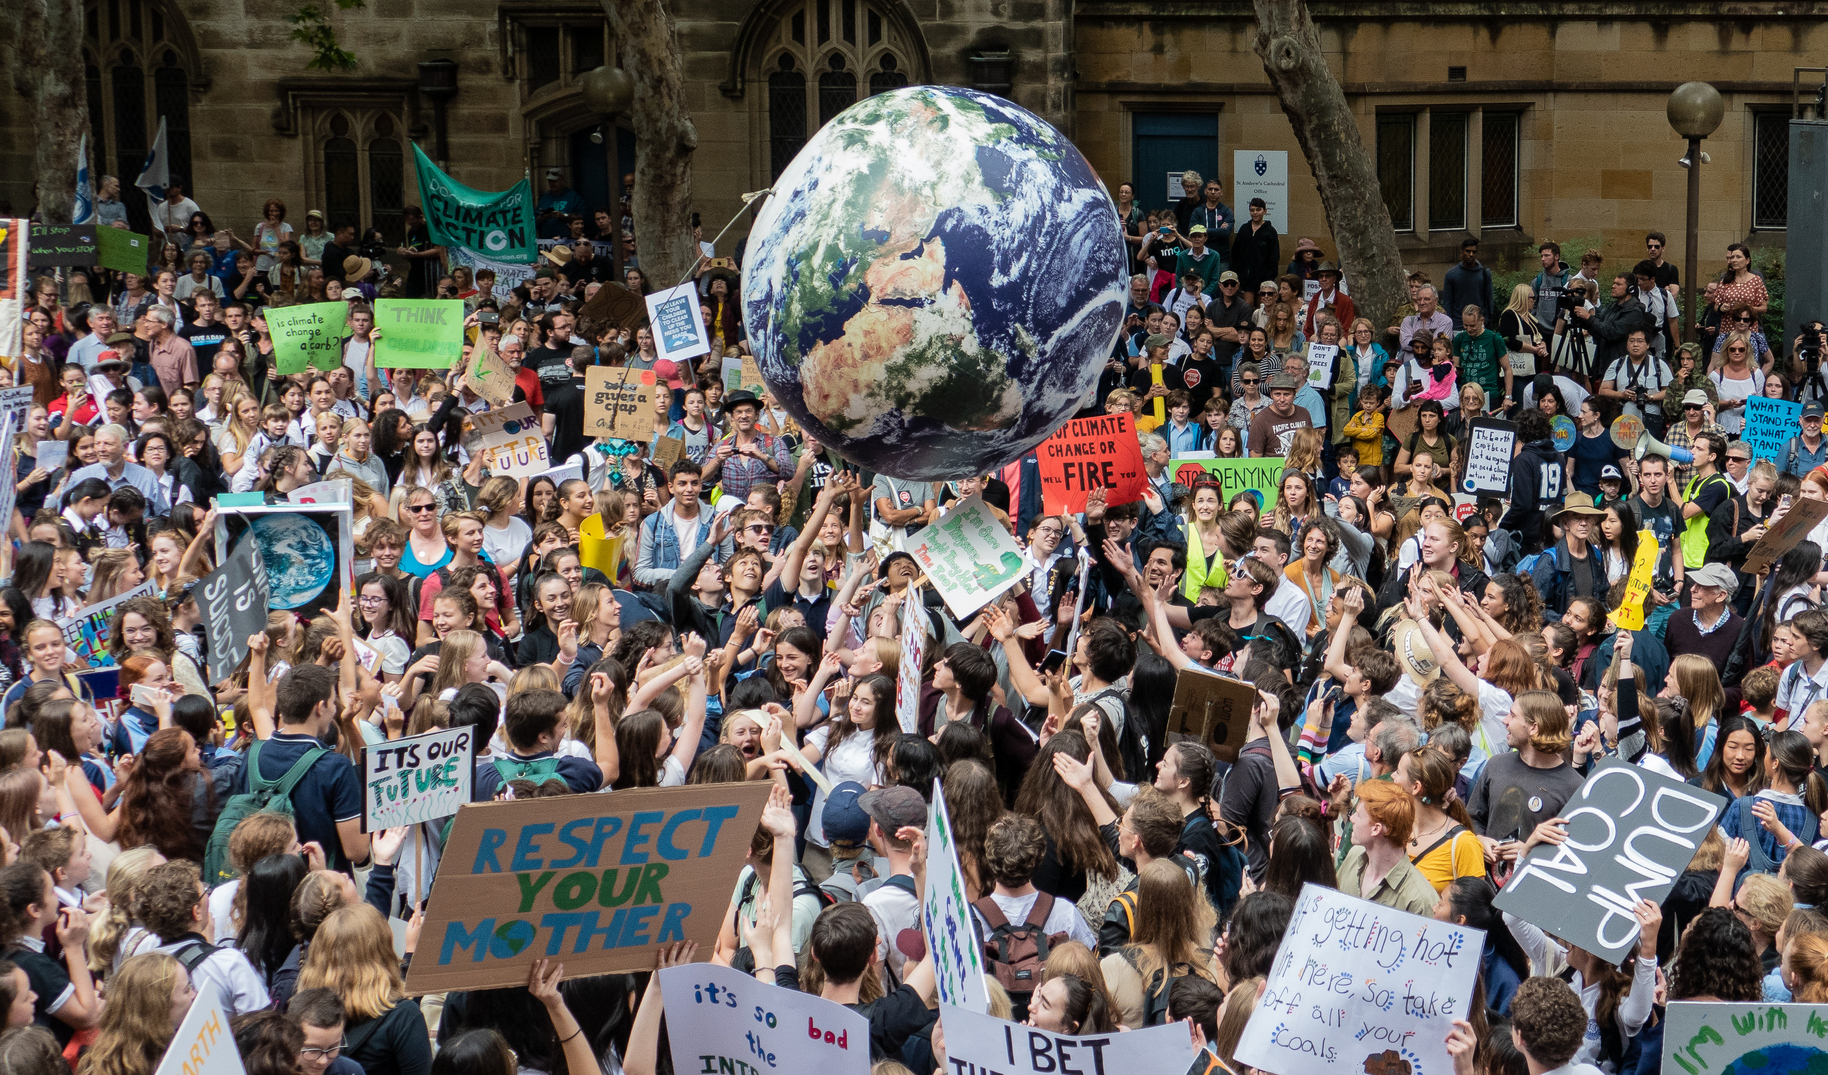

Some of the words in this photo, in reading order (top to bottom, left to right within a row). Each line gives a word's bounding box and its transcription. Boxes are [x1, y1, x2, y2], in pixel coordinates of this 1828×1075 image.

[430, 193, 523, 228] CLIMATE
[435, 213, 526, 251] ACTION
[276, 318, 285, 328] is
[287, 312, 324, 326] climate
[285, 328, 321, 340] change
[300, 342, 307, 350] a
[309, 336, 340, 351] carb?
[478, 411, 508, 427] IT'S
[1750, 400, 1781, 413] WHAT
[1786, 406, 1793, 415] I
[1751, 413, 1781, 426] STAND
[1072, 417, 1126, 437] CLIMATE
[1272, 423, 1290, 434] PACIFIC
[1746, 438, 1781, 451] STAND
[1749, 427, 1758, 437] IS
[1761, 428, 1786, 440] WHAT
[489, 436, 546, 470] FUTURE
[1048, 442, 1096, 457] CHANGE
[1100, 441, 1116, 454] OR
[1043, 476, 1062, 484] WE'LL
[1063, 461, 1117, 491] FIRE
[1540, 462, 1561, 499] 19
[233, 578, 256, 612] IS
[203, 573, 240, 679] SUICIDE
[374, 743, 421, 774] IT'S
[427, 732, 470, 760] OUR
[368, 756, 461, 809] FUTURE
[471, 805, 740, 875] RESPECT
[1506, 766, 1646, 894] COAL
[1586, 786, 1719, 950] DUMP
[516, 862, 670, 914] YOUR
[438, 902, 693, 966] MOTHER
[1314, 907, 1407, 969] getting
[1412, 928, 1459, 968] hot
[1299, 954, 1354, 999] here,
[1402, 980, 1454, 1016] take
[693, 982, 738, 1009] it's
[753, 1005, 778, 1029] so
[808, 1016, 848, 1051] bad
[1264, 986, 1302, 1015] off
[1311, 1008, 1341, 1028] all
[1358, 1021, 1415, 1048] your
[1731, 1006, 1788, 1035] with
[745, 1030, 778, 1069] the
[1003, 1024, 1016, 1066] I
[1028, 1031, 1111, 1075] BET
